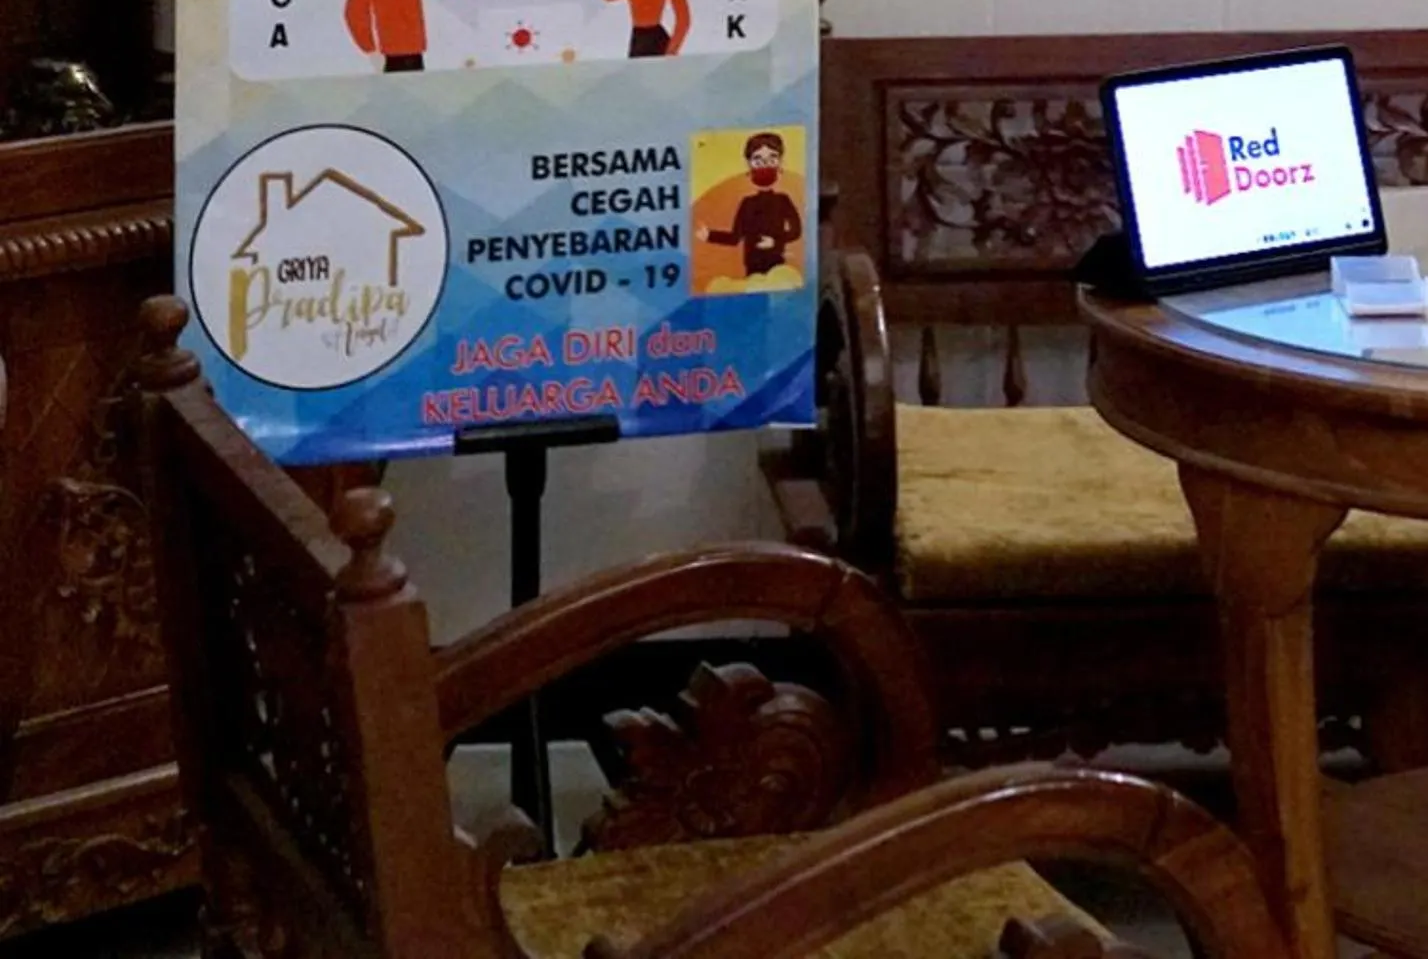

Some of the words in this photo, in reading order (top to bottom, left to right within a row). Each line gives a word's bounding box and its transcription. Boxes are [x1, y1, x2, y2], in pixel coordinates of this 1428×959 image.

[1227, 126, 1281, 161] Red
[531, 146, 682, 180] BERSAMA
[1234, 162, 1316, 192] Doorz
[570, 185, 680, 216] CEGAH
[467, 224, 680, 264] PENYEBARAN
[277, 255, 331, 284] GRIYA
[505, 268, 608, 301] COVID
[645, 262, 681, 289] 19
[451, 334, 553, 375] JAGA
[563, 326, 636, 365] DIRI
[647, 321, 716, 358] dan
[422, 376, 621, 424] KELUARGA
[633, 364, 747, 406] ANDA
